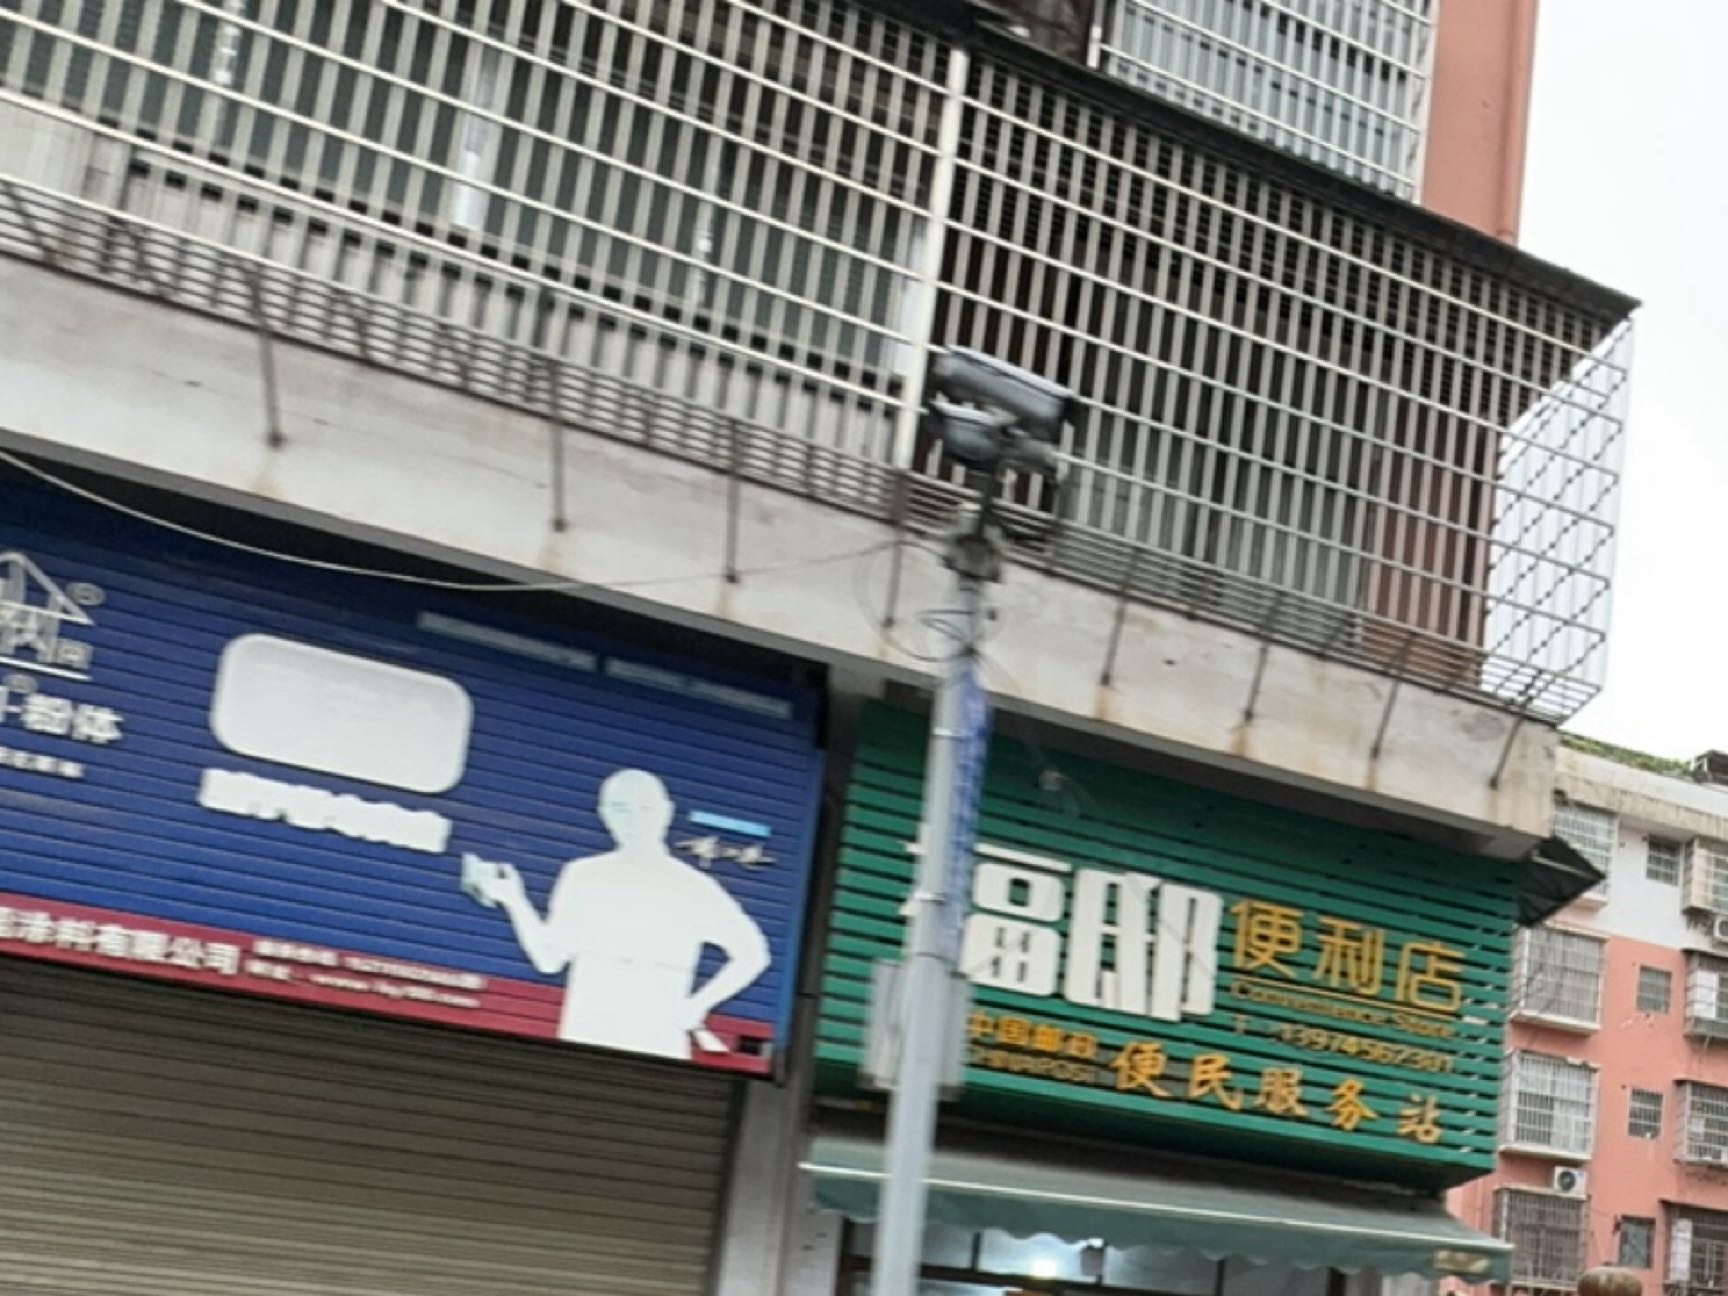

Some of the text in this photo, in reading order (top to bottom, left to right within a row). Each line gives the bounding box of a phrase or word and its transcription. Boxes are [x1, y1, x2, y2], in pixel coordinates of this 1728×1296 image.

[1231, 898, 1465, 1012] 便利店
[1110, 1040, 1443, 1145] 便民服务站
